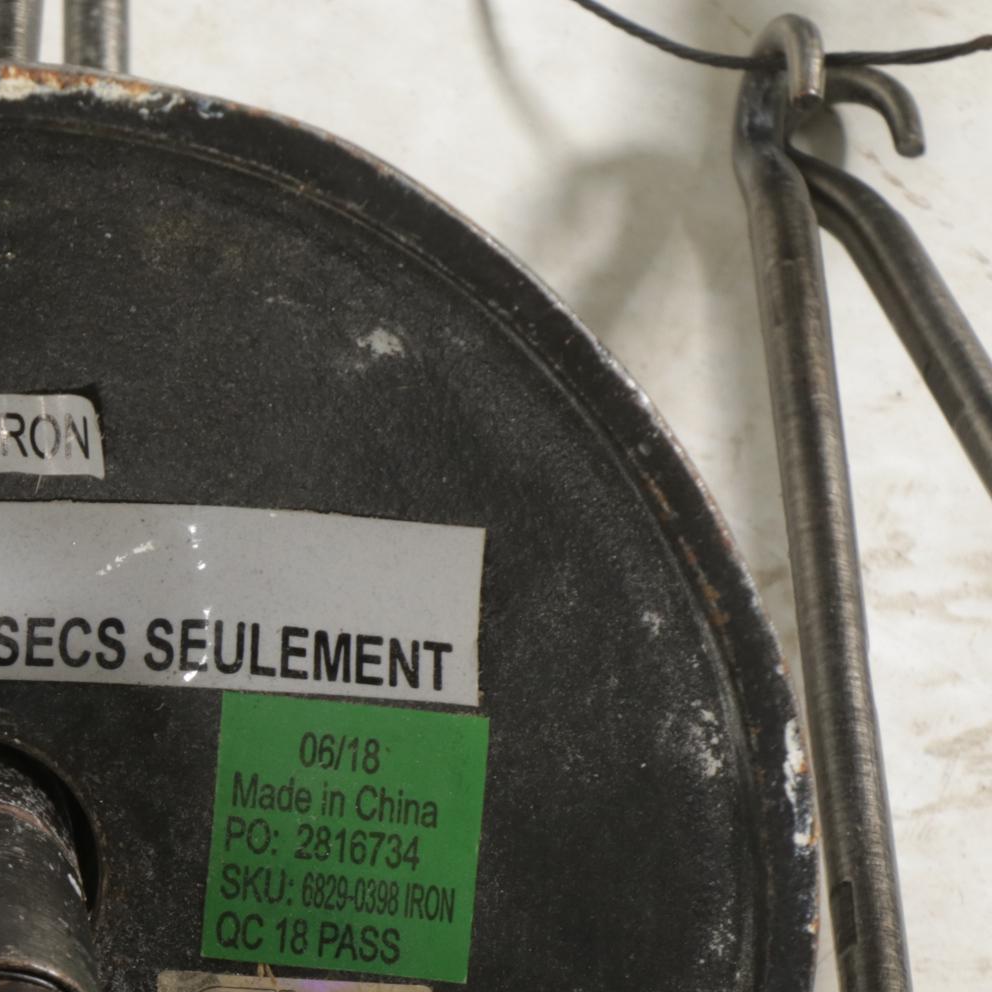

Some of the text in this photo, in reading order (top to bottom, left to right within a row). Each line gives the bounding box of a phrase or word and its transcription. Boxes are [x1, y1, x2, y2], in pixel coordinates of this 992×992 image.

[143, 618, 453, 691] SEULEMENT
[299, 732, 380, 775] 06/18
[231, 770, 439, 829] Made in China
[224, 815, 420, 871] PO: 2816734
[219, 863, 456, 925] SKU: 6829-0398 IRON
[215, 910, 401, 965] QC 18 PASS
